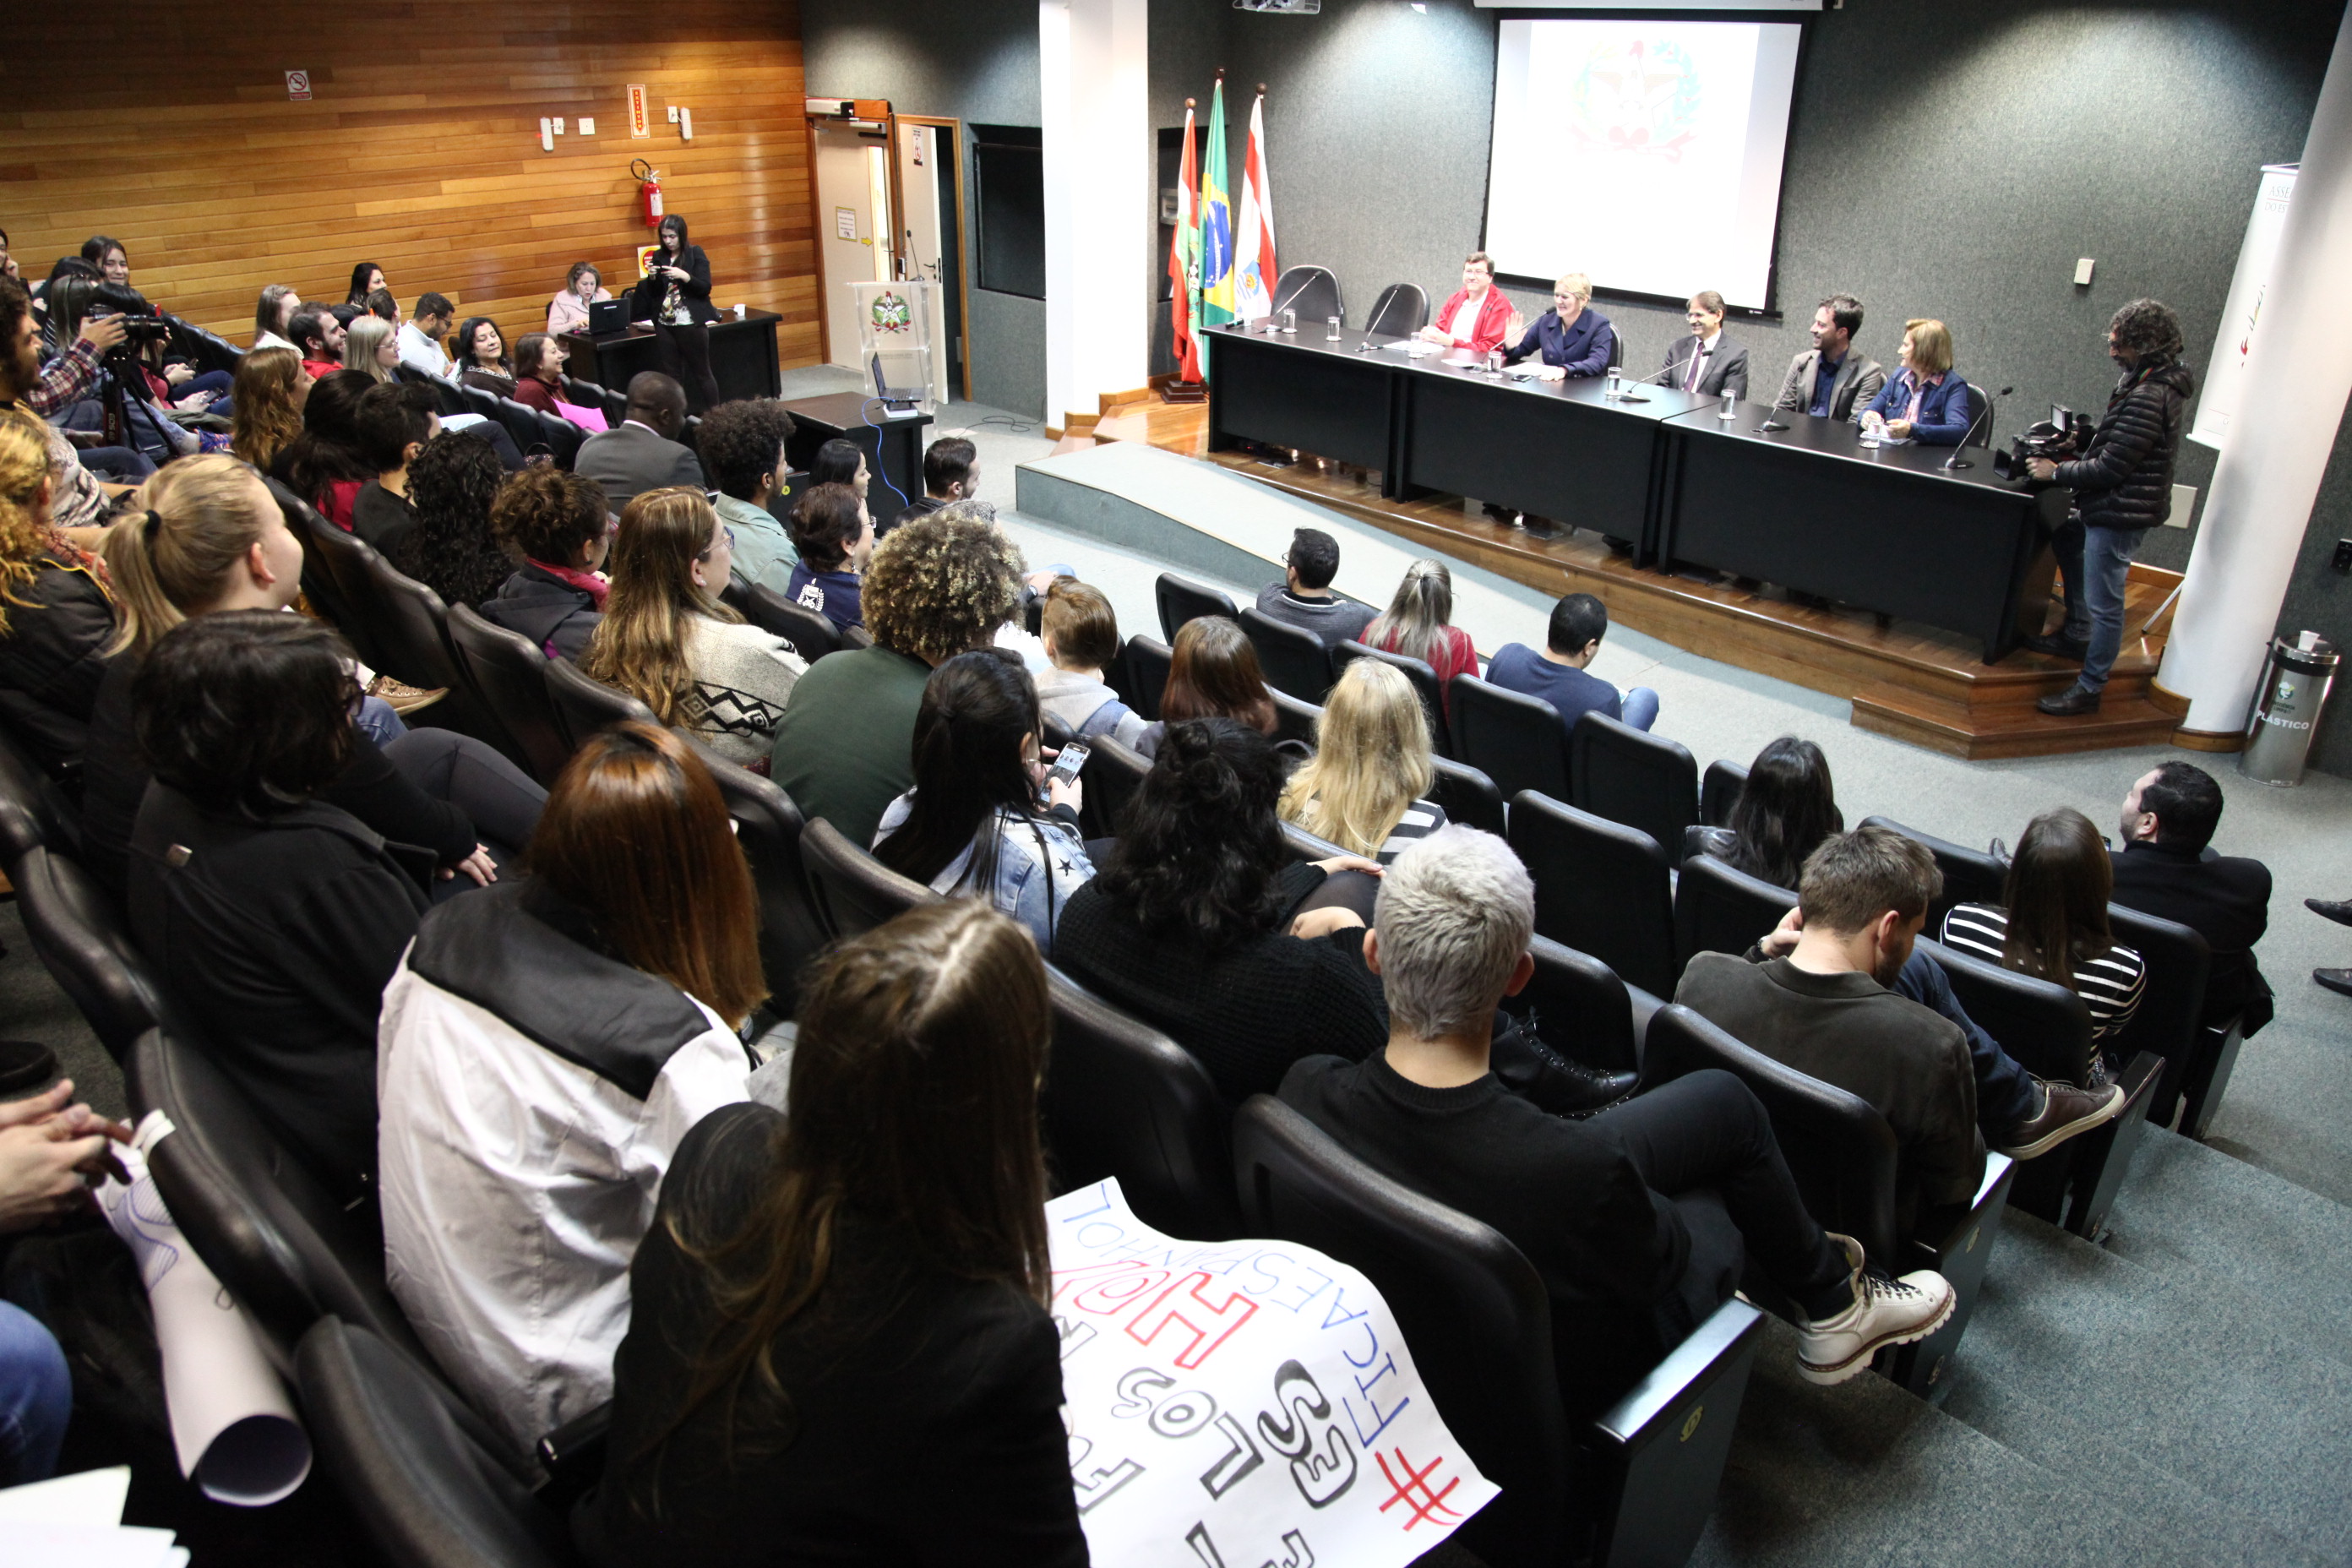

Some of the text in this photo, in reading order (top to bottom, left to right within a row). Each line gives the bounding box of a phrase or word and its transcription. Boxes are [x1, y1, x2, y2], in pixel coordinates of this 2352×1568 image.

[2268, 186, 2290, 199] ASSE
[2257, 710, 2310, 730] PLÁSTICO
[1110, 1367, 1265, 1500] LOS
[1257, 1359, 1358, 1509] ES
